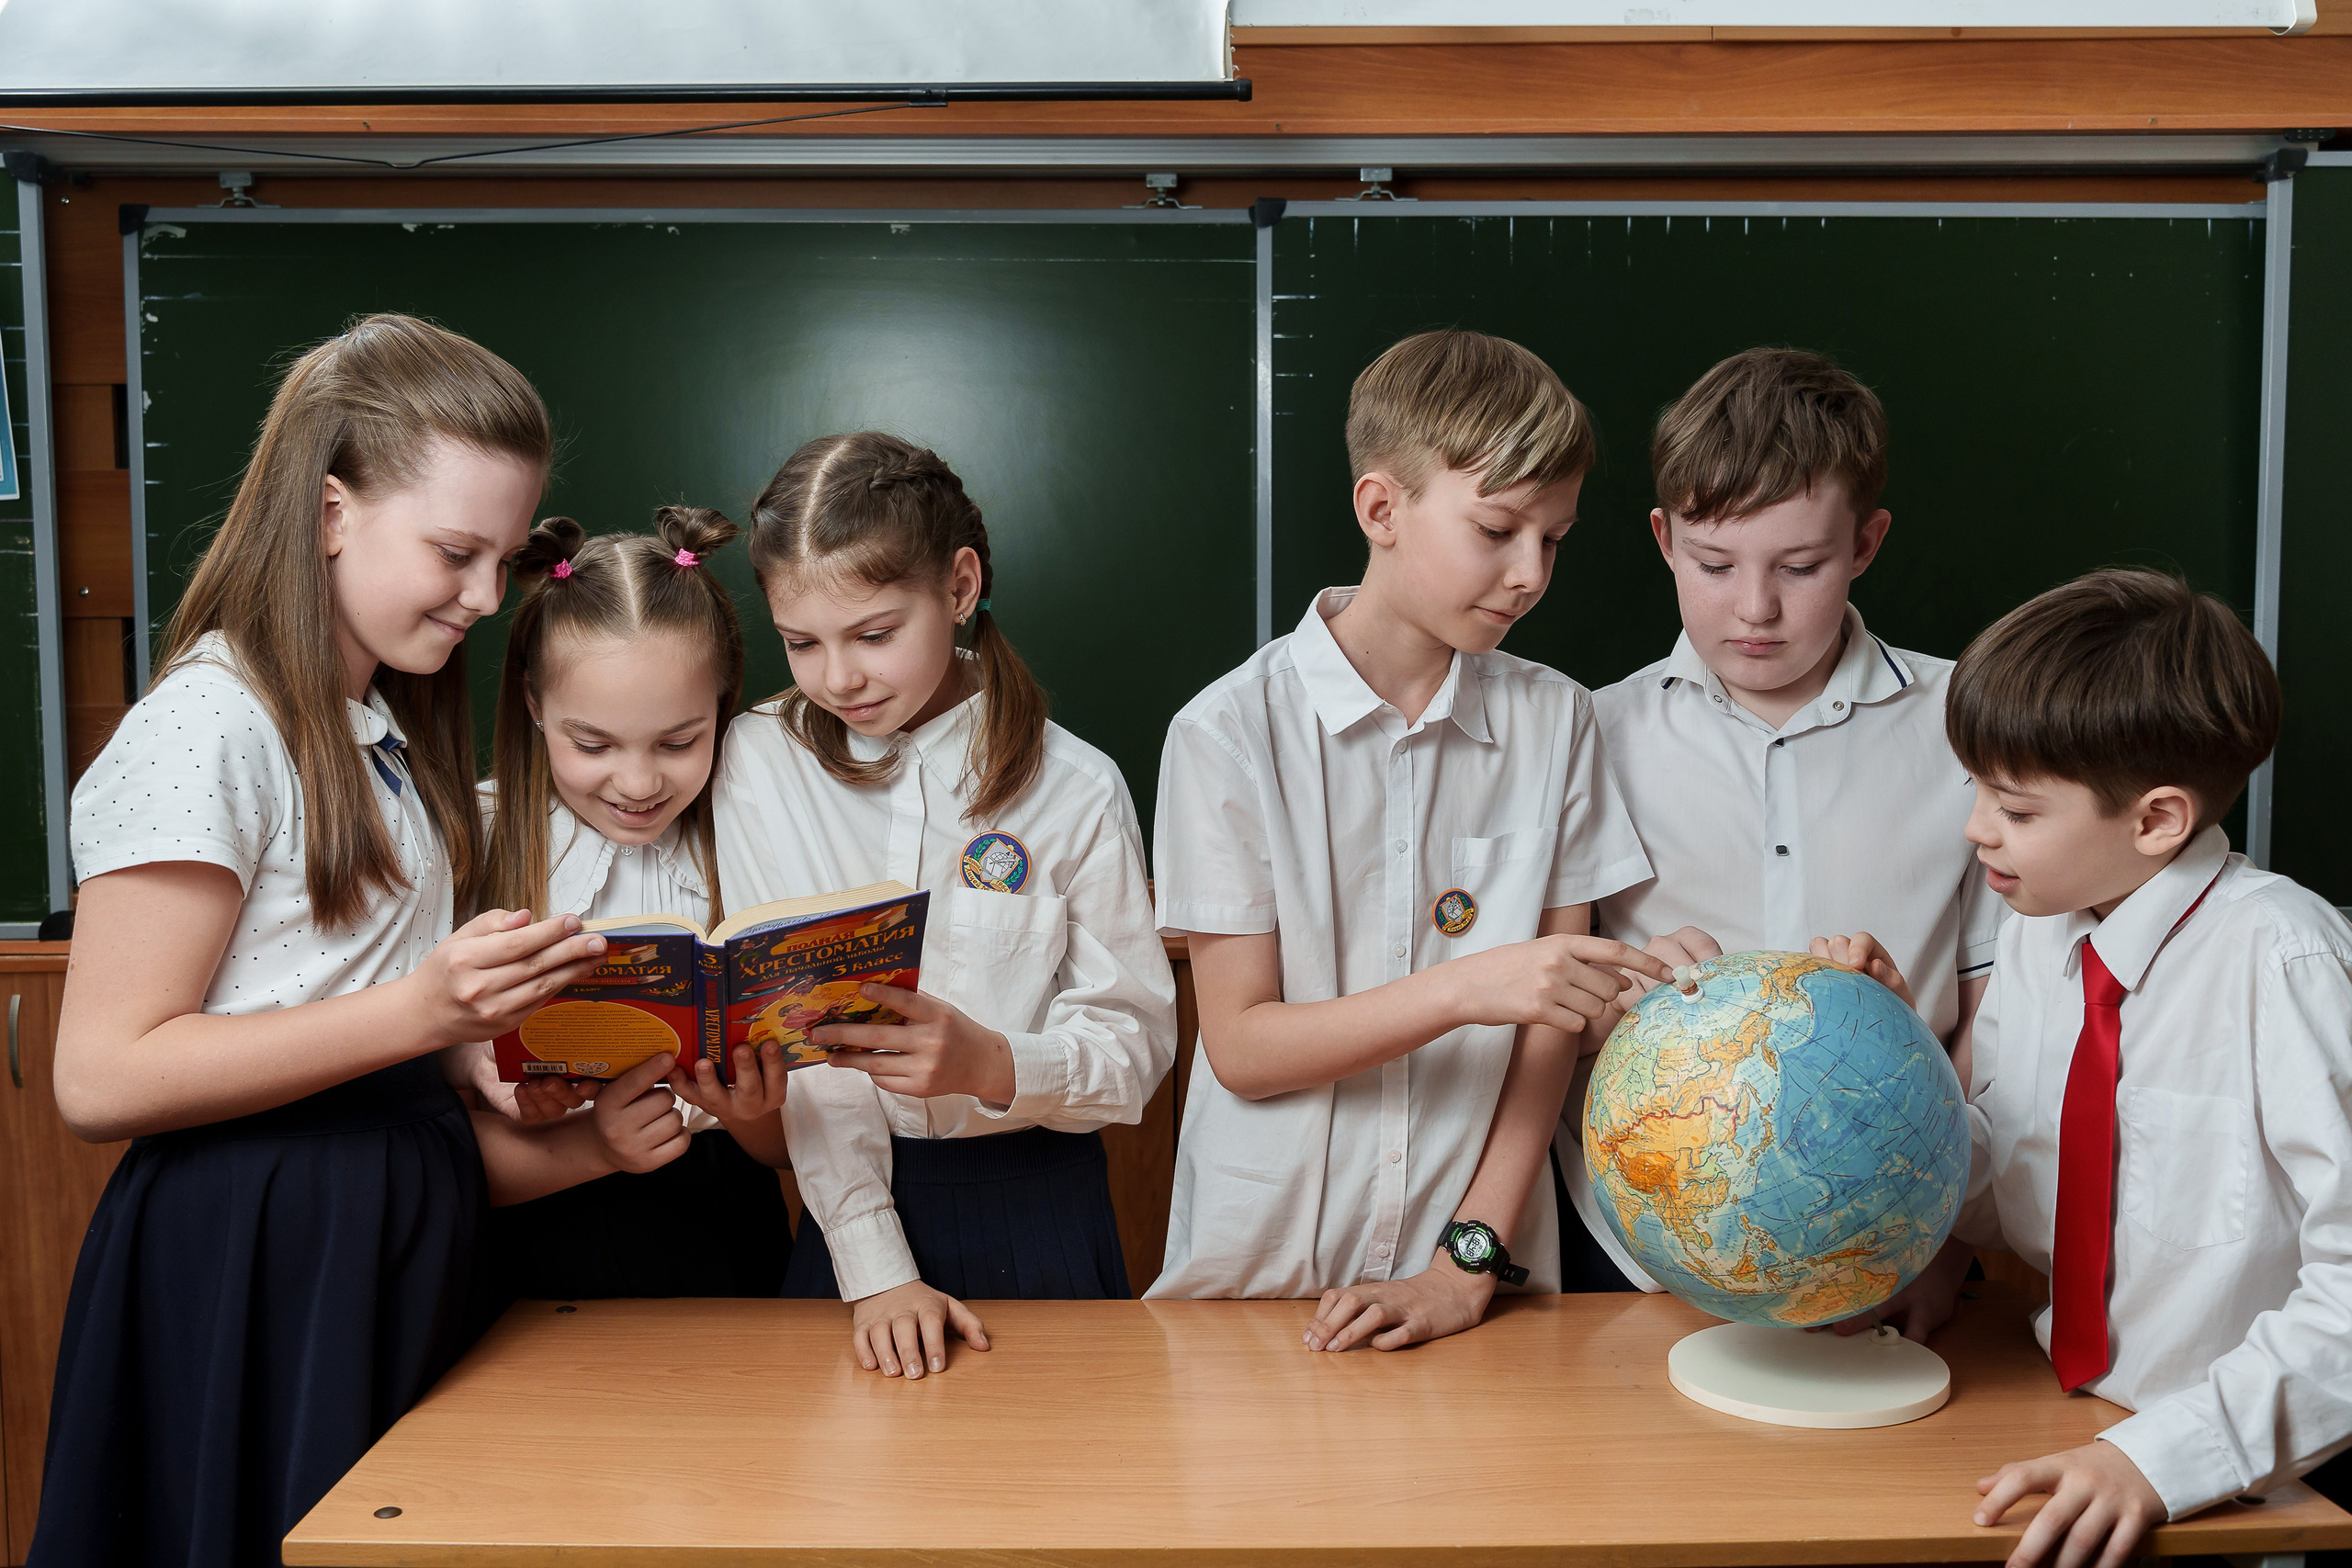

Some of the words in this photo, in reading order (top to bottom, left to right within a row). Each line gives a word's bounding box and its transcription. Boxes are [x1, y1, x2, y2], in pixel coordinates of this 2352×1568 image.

[786, 931, 855, 953] ПОЛНАЯ
[703, 953, 718, 964] 3
[740, 925, 915, 979] ХРЕСТОМАТИЯ
[596, 965, 672, 976] ОМАТИЯ
[760, 971, 780, 982] для
[831, 964, 847, 977] 3
[705, 1007, 721, 1064] ХРЕСТОМАТИЯ
